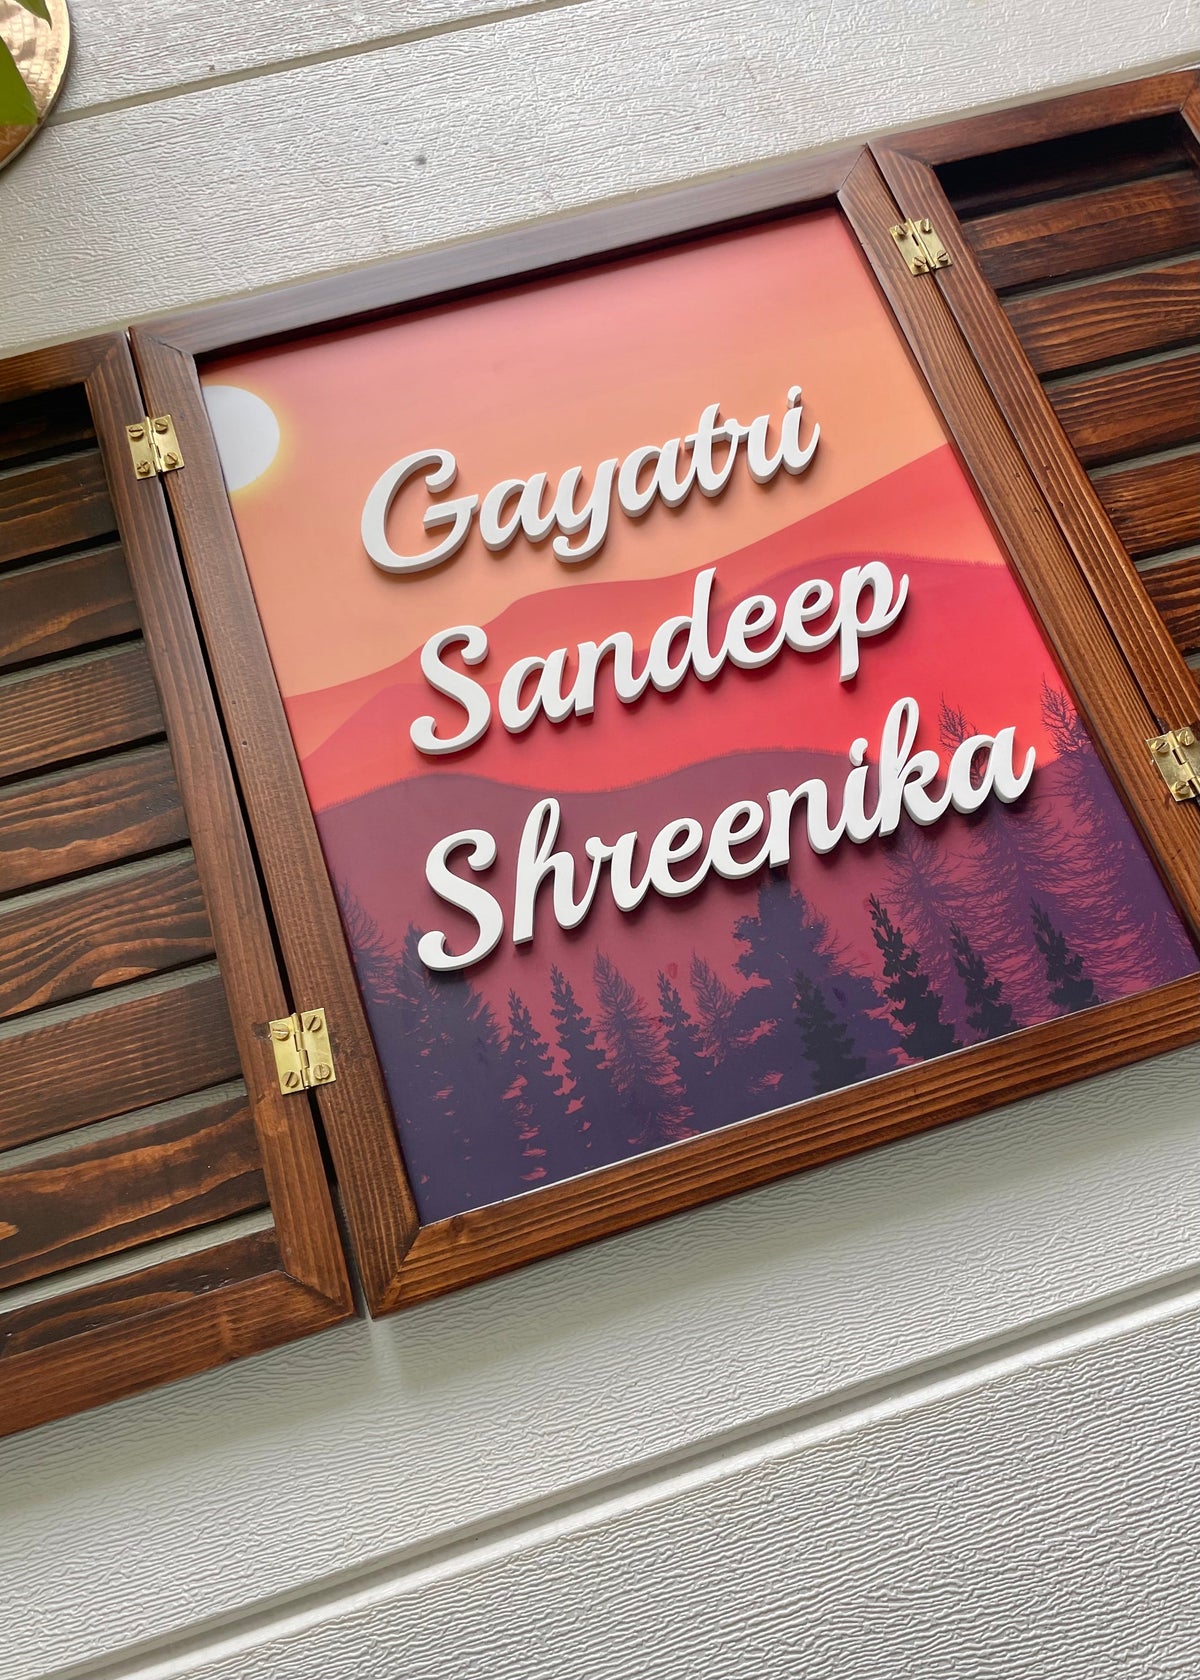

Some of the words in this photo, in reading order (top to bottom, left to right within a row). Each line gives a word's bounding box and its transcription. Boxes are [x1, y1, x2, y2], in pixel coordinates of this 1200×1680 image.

[360, 386, 821, 573] Gayatri
[409, 560, 909, 755] Sandeep
[417, 697, 1036, 972] Shreenika
